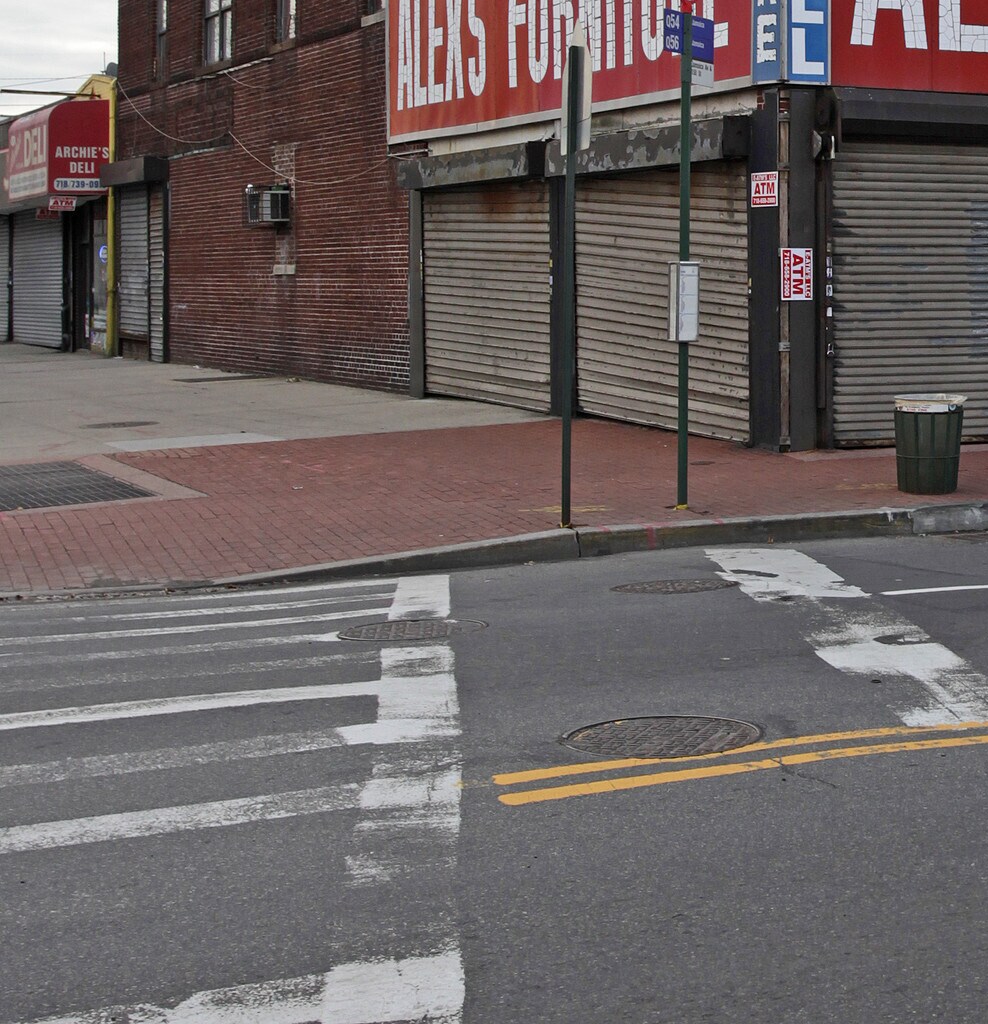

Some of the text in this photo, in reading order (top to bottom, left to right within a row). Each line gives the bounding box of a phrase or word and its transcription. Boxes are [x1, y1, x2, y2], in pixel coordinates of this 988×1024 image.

[666, 14, 680, 30] Q54
[665, 34, 680, 50] Q56
[24, 125, 46, 166] DELI
[55, 146, 109, 159] ARCHIE'S
[70, 161, 95, 174] DELI
[754, 182, 775, 194] ATM
[793, 253, 803, 294] ATM
